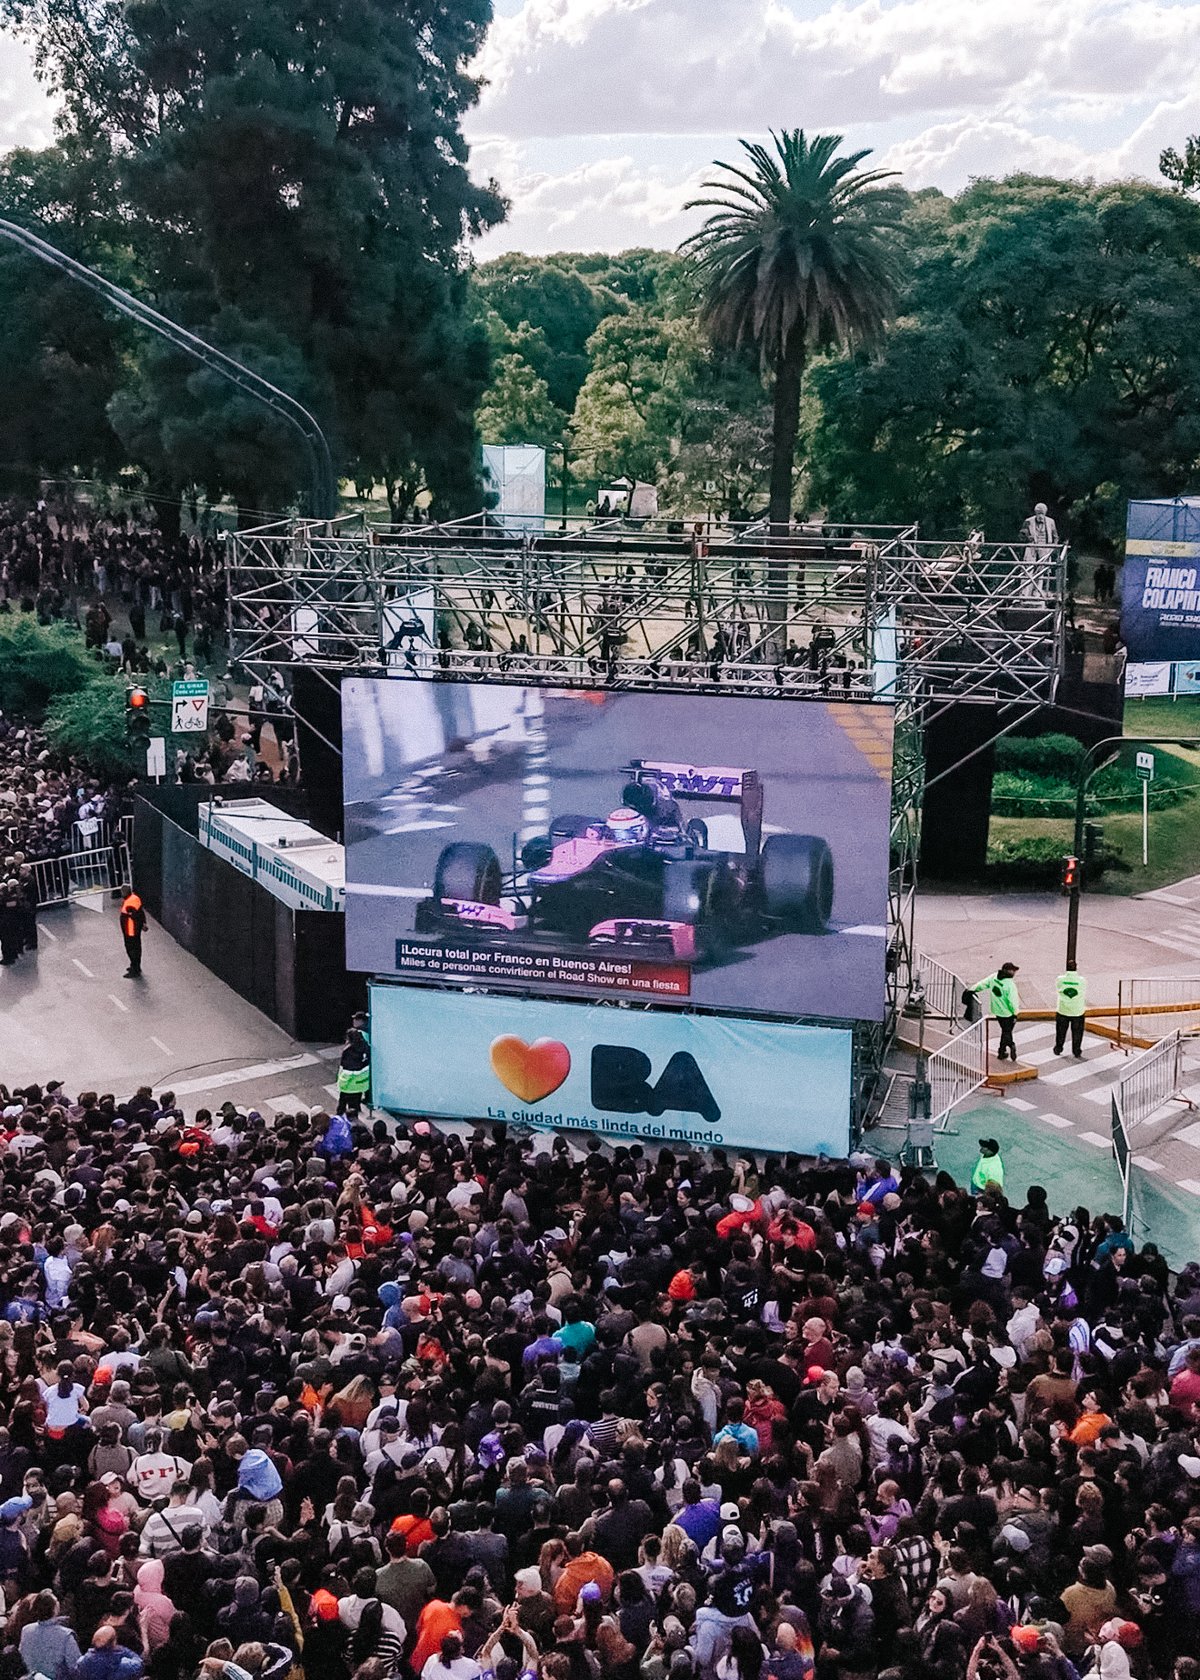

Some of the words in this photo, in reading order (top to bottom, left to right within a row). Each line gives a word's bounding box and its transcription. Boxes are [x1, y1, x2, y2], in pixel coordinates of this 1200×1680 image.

[1145, 567, 1197, 590] FRANCO
[401, 944, 442, 957] ¡Locura
[445, 948, 470, 960] total
[472, 951, 491, 962] por
[494, 952, 532, 966] Franco
[535, 958, 550, 966] en
[552, 957, 595, 972] Buenos
[598, 961, 632, 974] Aires!
[401, 957, 426, 967] Miles
[428, 959, 440, 969] de
[442, 961, 487, 973] personas
[488, 965, 545, 978] convirtieron
[547, 970, 557, 979] el
[559, 970, 585, 982] Road
[587, 973, 615, 985] Show
[617, 977, 630, 986] en
[632, 979, 651, 988] una
[653, 980, 680, 991] fiesta
[591, 1044, 721, 1122] BA
[487, 1106, 506, 1119] La
[512, 1109, 563, 1125] ciudad
[566, 1113, 598, 1129] más
[601, 1118, 639, 1134] linda
[642, 1121, 666, 1138] del
[669, 1126, 724, 1143] mundo
